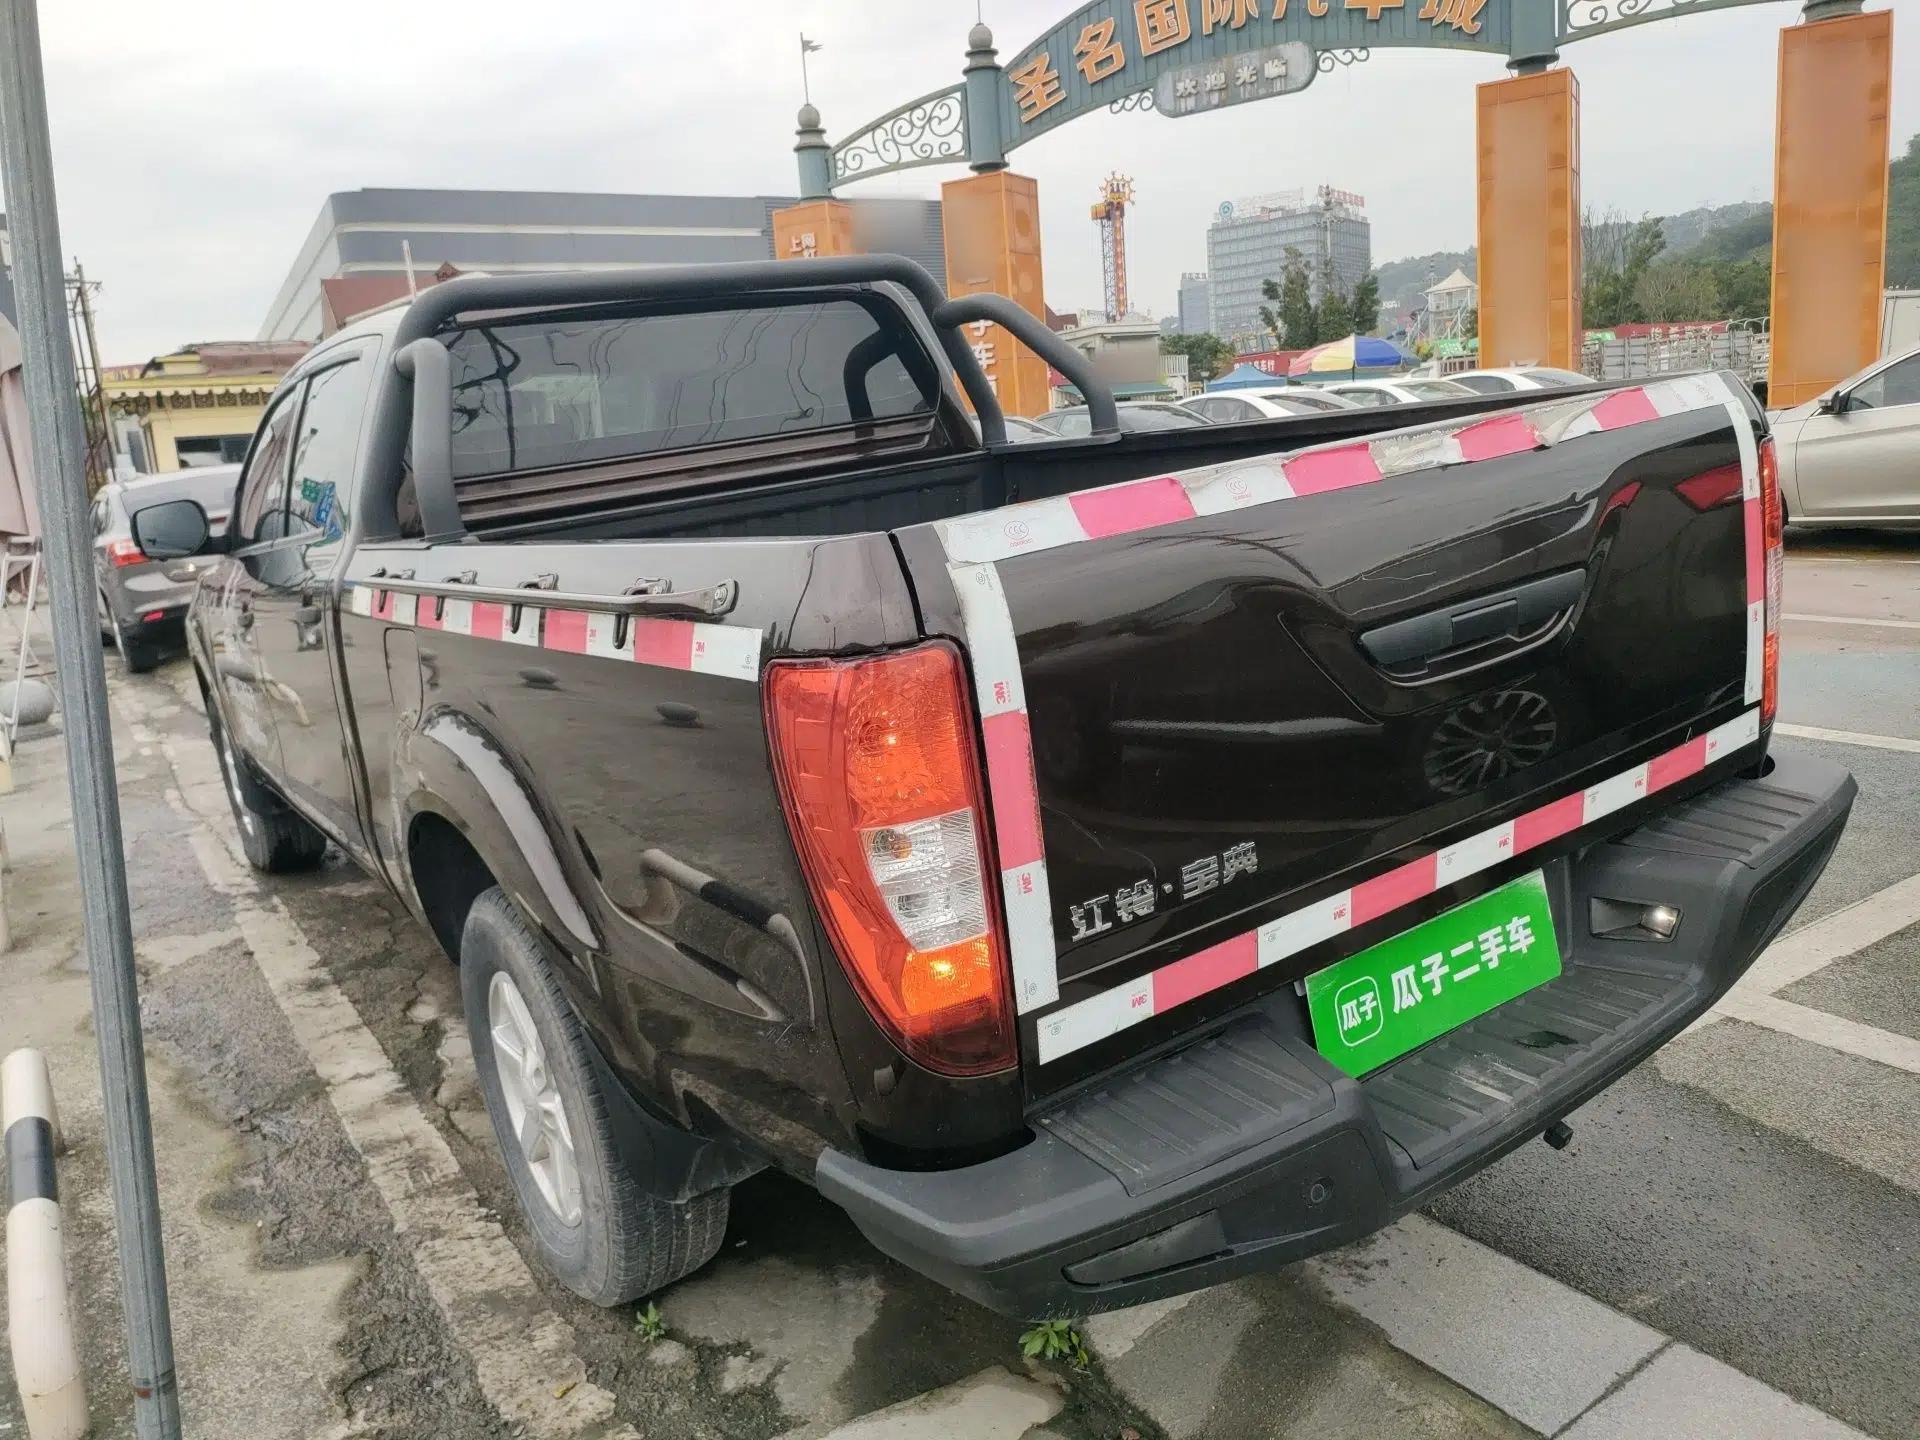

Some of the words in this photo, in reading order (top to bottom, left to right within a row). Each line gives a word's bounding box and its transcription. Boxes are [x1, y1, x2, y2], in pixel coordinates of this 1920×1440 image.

[1176, 57, 1287, 97] 欢迎光临
[994, 682, 1006, 704] 3M
[1021, 872, 1033, 894] 3M
[1391, 915, 1536, 1014] 瓜子二手车
[1341, 991, 1377, 1031] 瓜子
